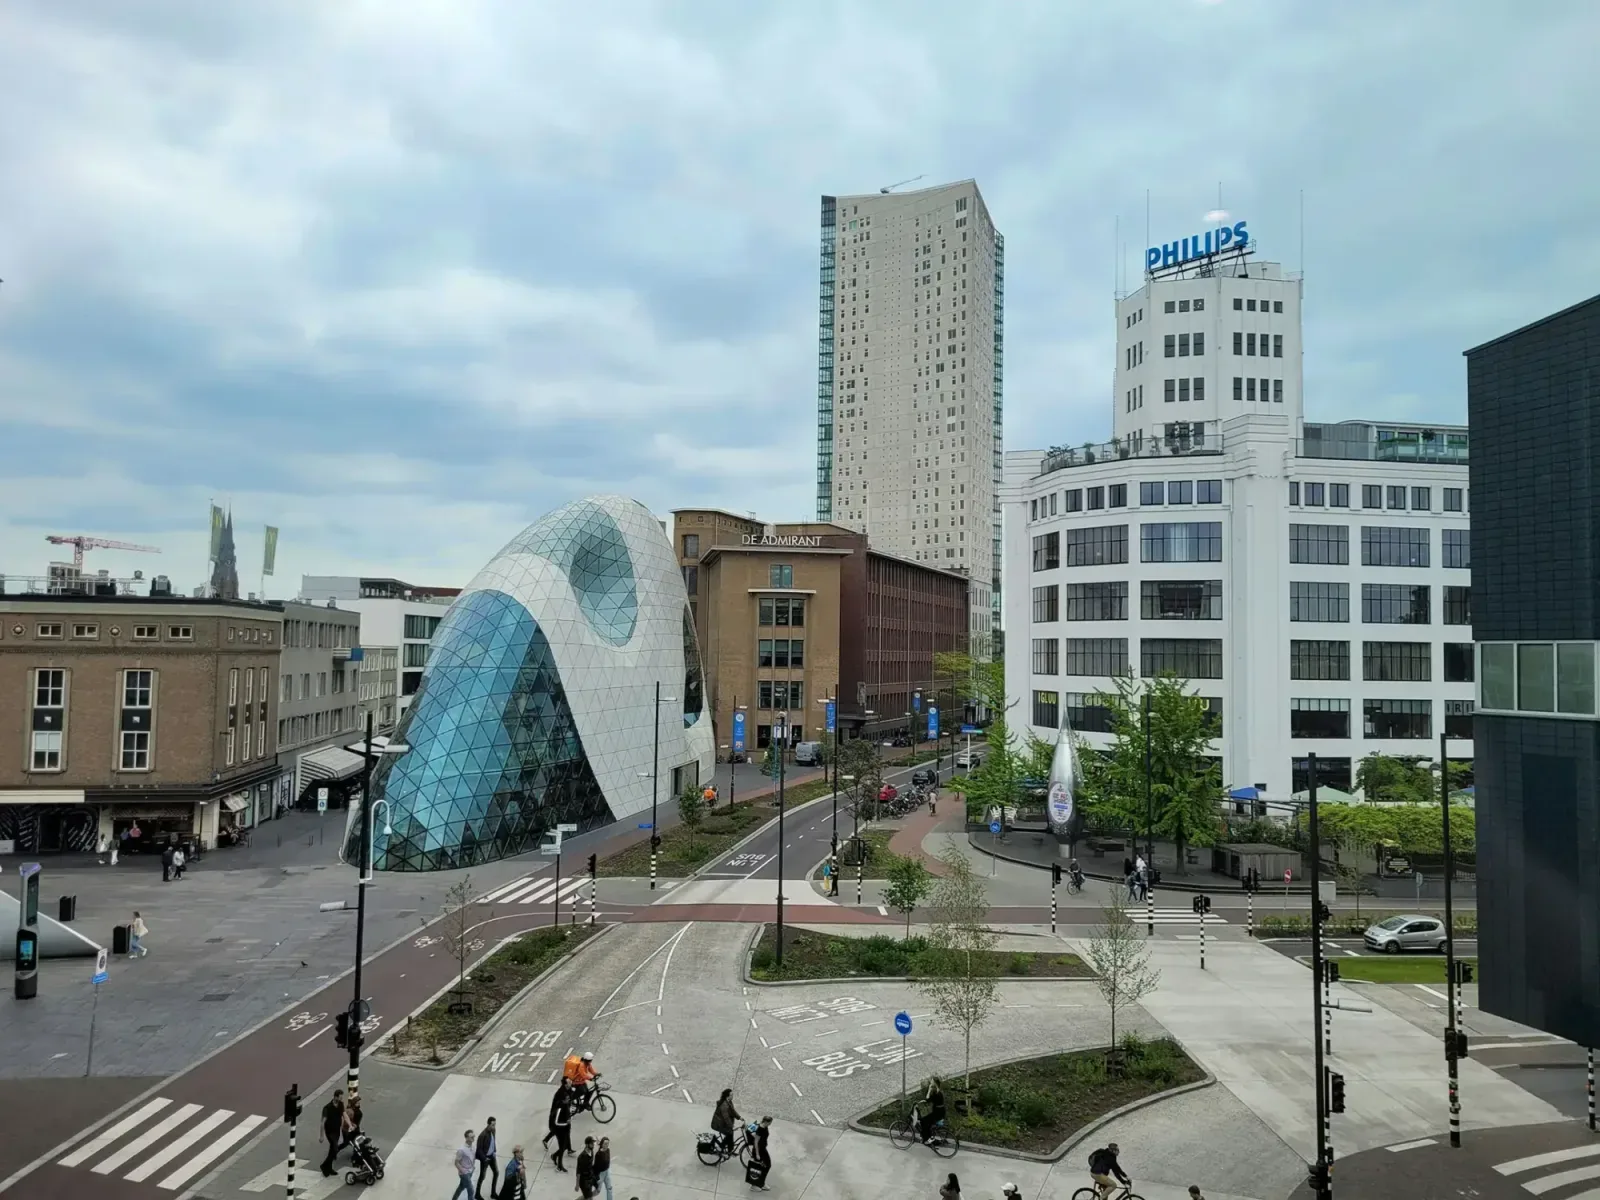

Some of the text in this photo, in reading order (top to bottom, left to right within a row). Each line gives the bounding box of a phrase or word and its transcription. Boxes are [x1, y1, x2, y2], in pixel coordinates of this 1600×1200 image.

[1145, 221, 1249, 270] PHILIPS
[741, 534, 822, 547] DE ADMIRANT
[818, 996, 877, 1015] BUS
[503, 1030, 564, 1049] BUS
[801, 1051, 872, 1078] BUS
